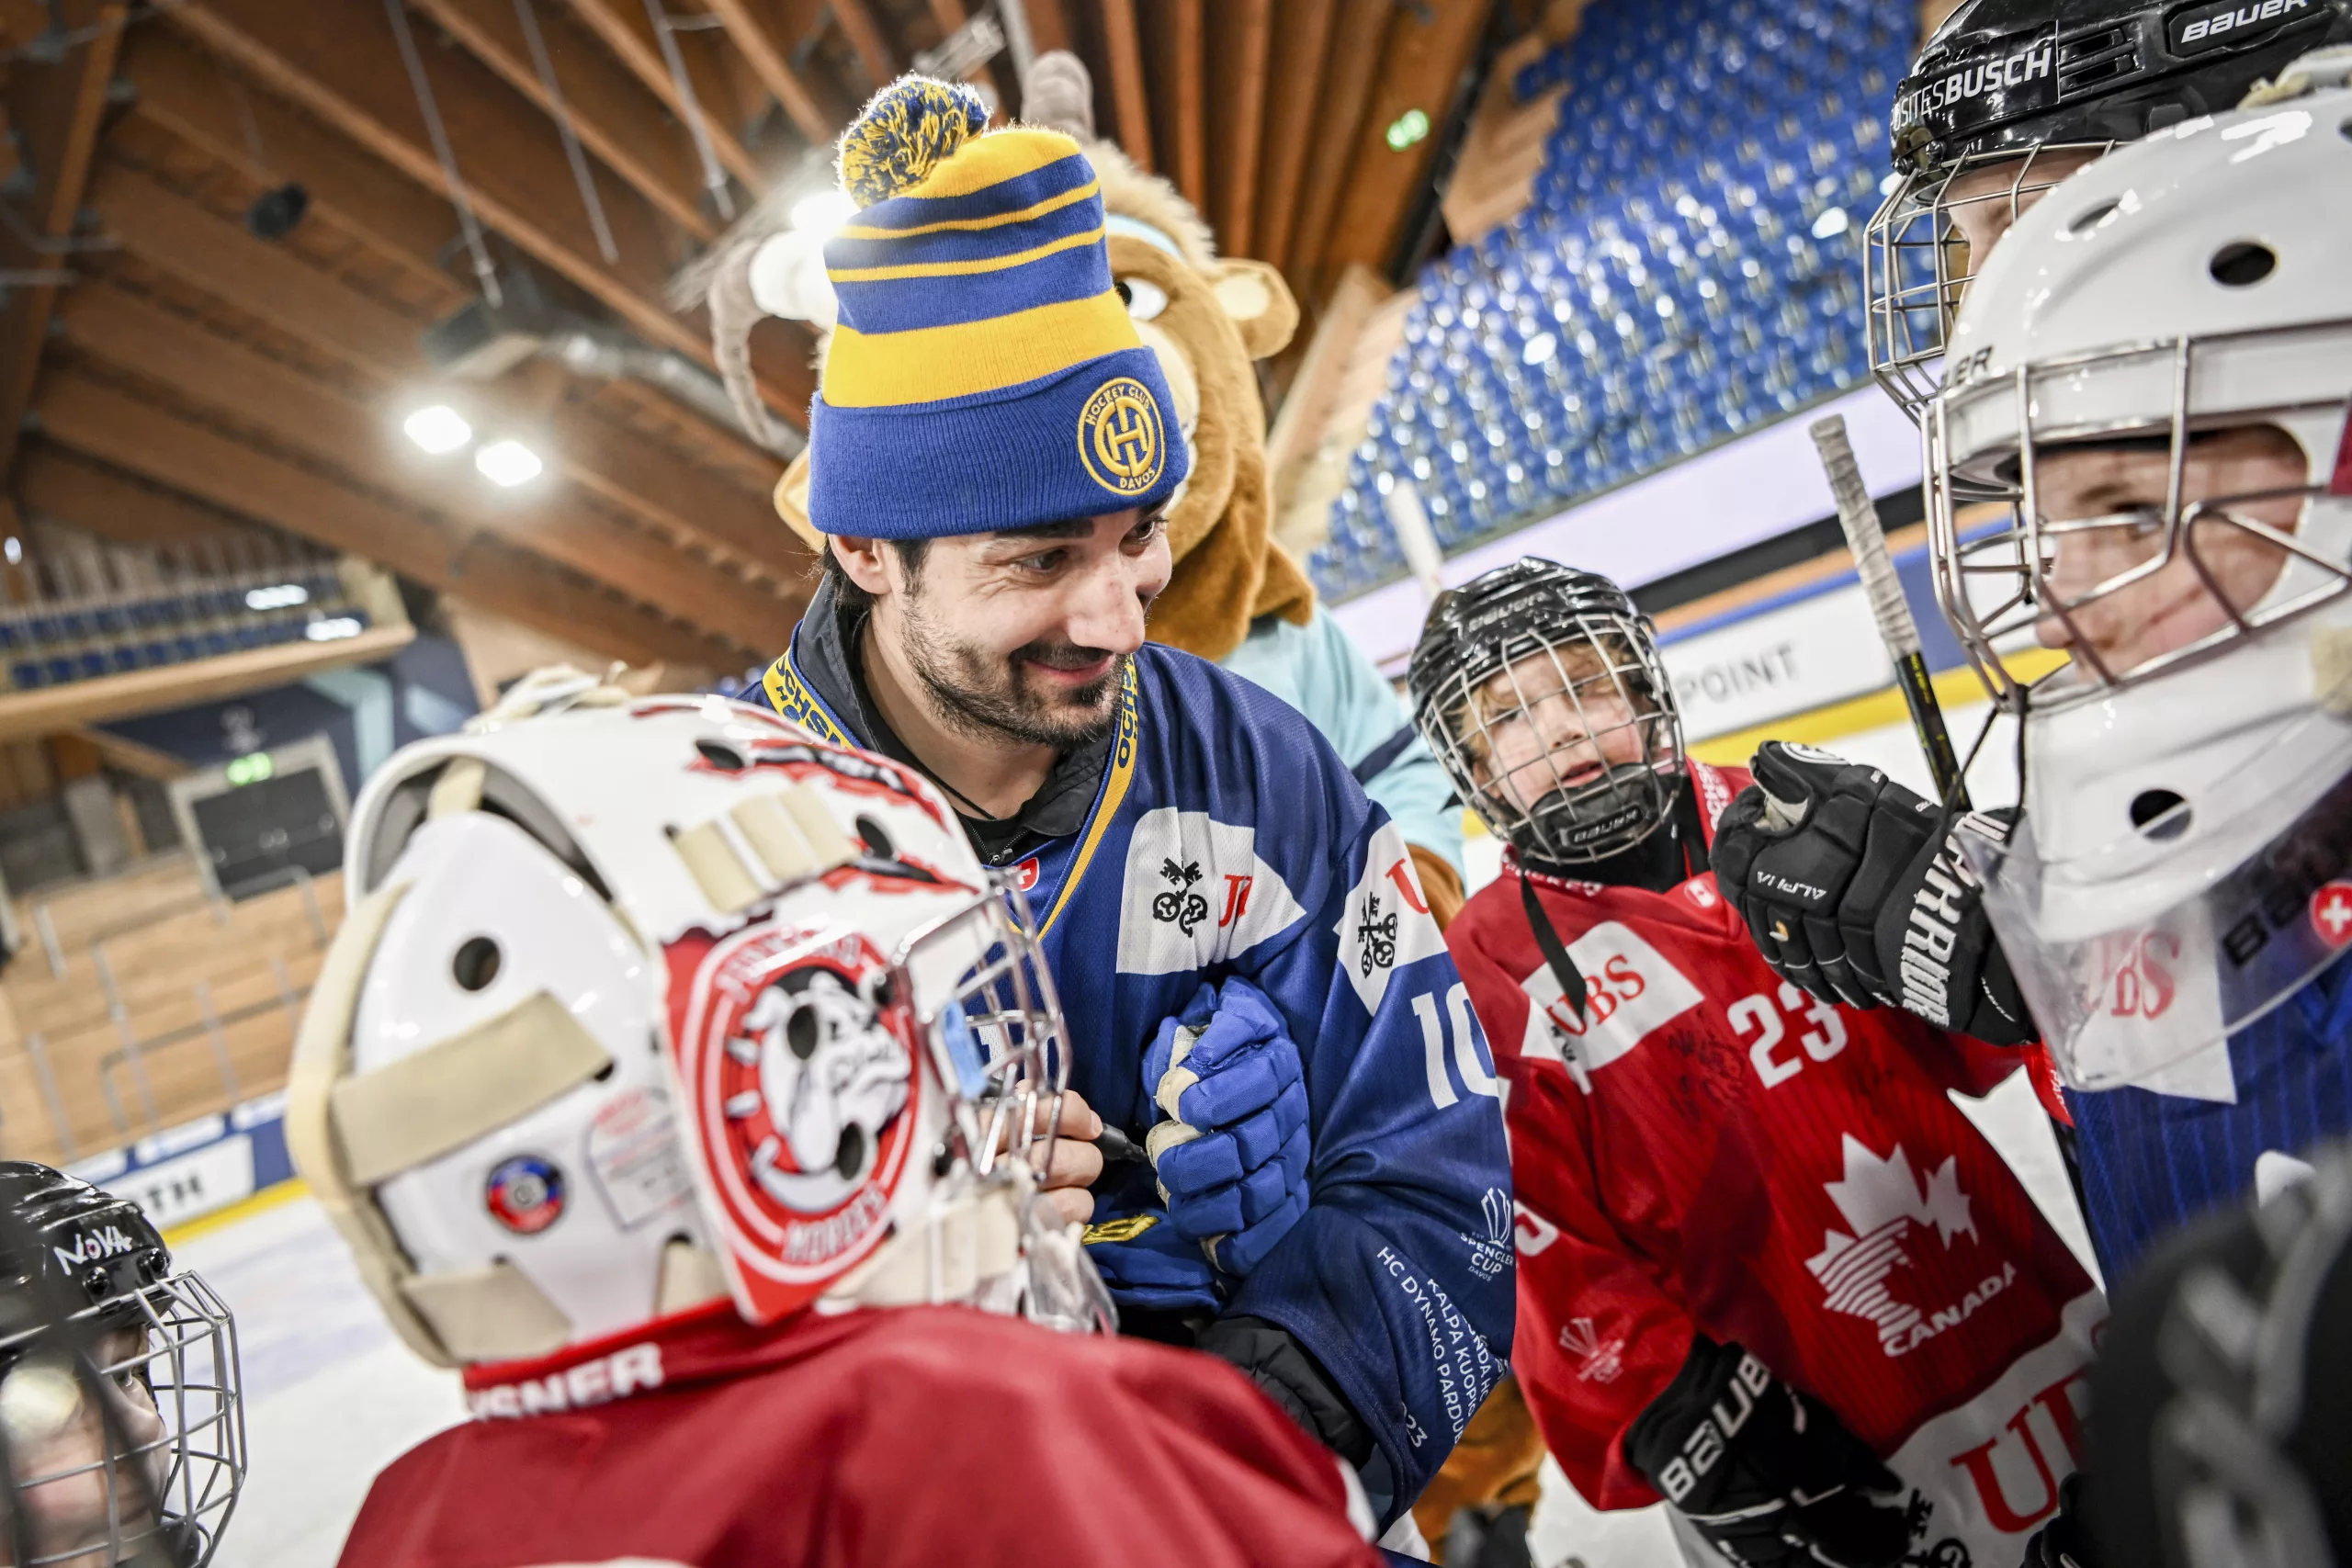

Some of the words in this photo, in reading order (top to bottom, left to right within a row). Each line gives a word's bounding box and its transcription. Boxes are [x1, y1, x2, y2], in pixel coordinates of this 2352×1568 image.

[1085, 386, 1125, 425] HOCKEY
[1128, 387, 1151, 410] CLUB
[1119, 467, 1156, 490] DAVOS
[1674, 645, 1798, 713] POINT
[1757, 871, 1826, 900] ALPHA
[1545, 953, 1646, 1037] UBS
[1410, 981, 1499, 1110] 10
[1726, 980, 1849, 1090] 23
[146, 1175, 203, 1212] TH
[1460, 1232, 1514, 1267] SPENGLER
[1467, 1266, 1493, 1281] DAVOS
[1471, 1252, 1503, 1274] CUP
[1376, 1246, 1405, 1278] HC
[1401, 1275, 1445, 1360] DYNAMO
[1427, 1278, 1464, 1345] KALPA
[1658, 1352, 1771, 1504] BAUE
